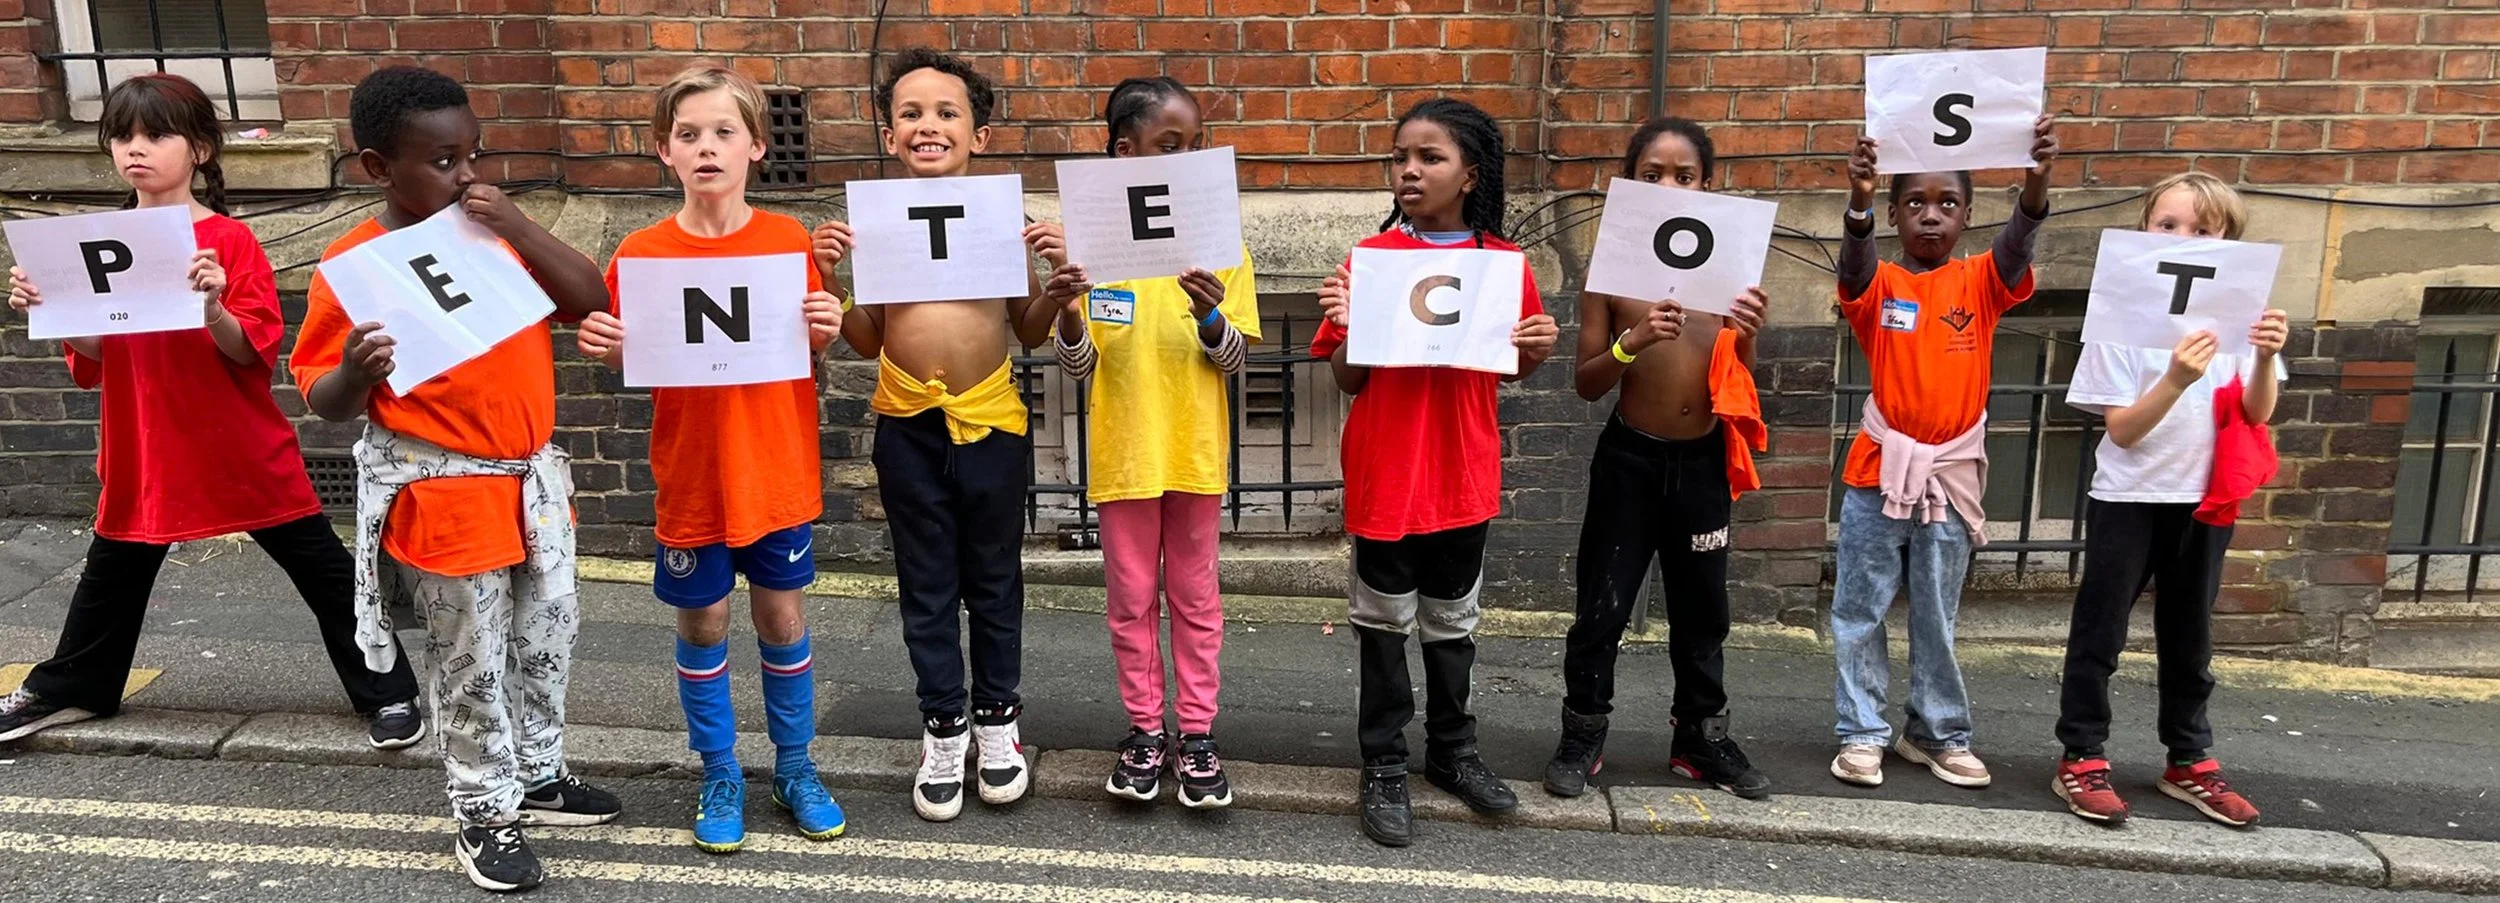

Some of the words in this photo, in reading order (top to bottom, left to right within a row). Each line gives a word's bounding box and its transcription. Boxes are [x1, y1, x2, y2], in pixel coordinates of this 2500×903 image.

[1933, 93, 1974, 147] S
[907, 205, 965, 260] T
[1126, 184, 1176, 241] E
[78, 239, 134, 294] P
[1653, 216, 1714, 270] O
[408, 253, 473, 314] E
[1409, 274, 1462, 327] C
[2157, 261, 2217, 315] T
[109, 312, 129, 321] 020
[683, 286, 751, 344] N
[1101, 304, 1124, 318] Tyra
[711, 363, 728, 371] 877
